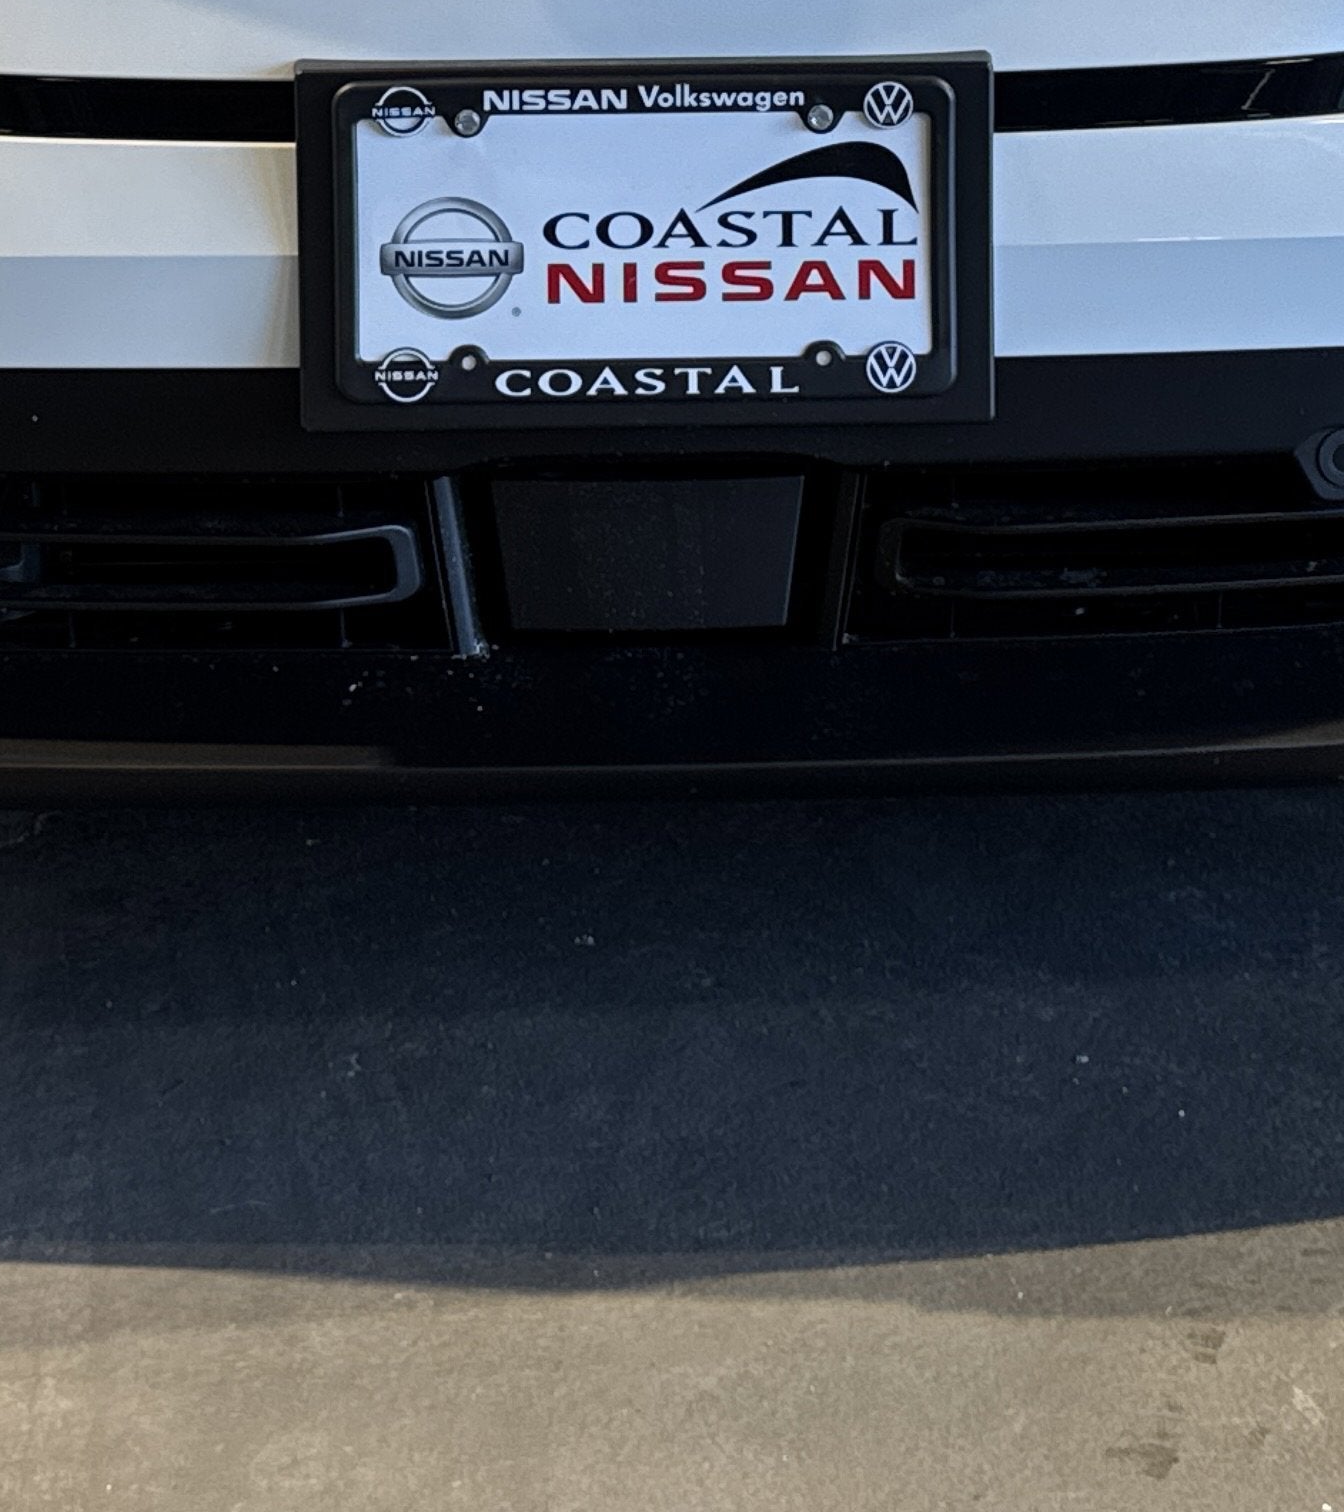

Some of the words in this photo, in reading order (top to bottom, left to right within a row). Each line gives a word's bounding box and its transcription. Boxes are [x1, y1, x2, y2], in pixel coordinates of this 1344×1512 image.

[483, 89, 628, 111] NISSAN
[638, 83, 805, 111] Volkswagen
[372, 105, 436, 118] NISSAN
[543, 205, 918, 250] COASTAL
[394, 249, 510, 268] NISSAN
[547, 259, 916, 304] NISSAN
[375, 369, 439, 382] NISSAN
[495, 364, 800, 397] COASTAL
